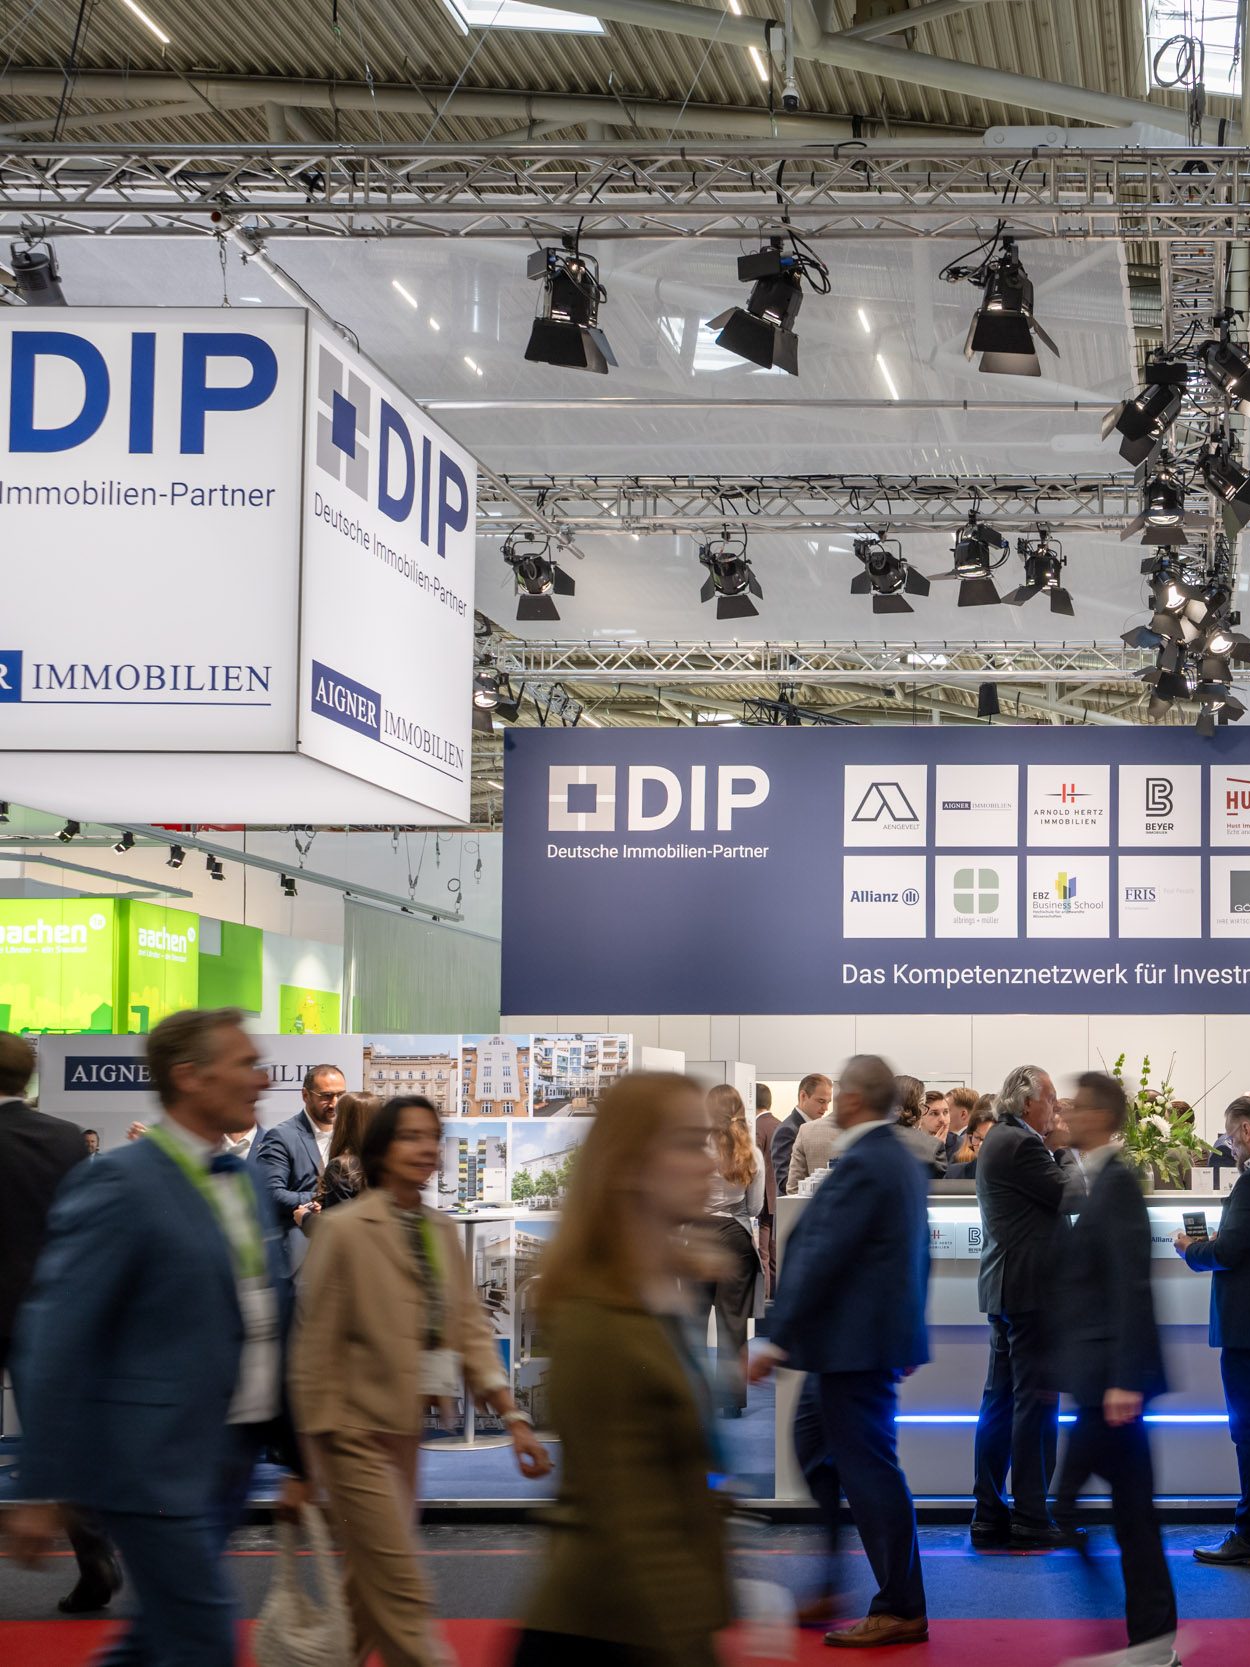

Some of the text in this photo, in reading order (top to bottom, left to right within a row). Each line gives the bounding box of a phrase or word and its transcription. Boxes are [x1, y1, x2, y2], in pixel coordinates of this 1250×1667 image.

[9, 331, 279, 455] DIP
[378, 397, 470, 559] DIP
[0, 479, 276, 508] Immobilien-Partner
[314, 491, 468, 619] Deutsche Immobilien-Partner
[33, 664, 272, 692] IMMOBILIEN
[315, 674, 464, 770] AIGNER IMMOBILIEN
[627, 765, 770, 831] DIP
[944, 802, 1012, 810] AIGNER IMMOBILIEN
[1145, 822, 1174, 831] BEYER
[547, 844, 769, 858] Deutsche Immobilien-Partner
[850, 890, 899, 903] Allianz
[1032, 892, 1050, 900] EBZ
[1032, 901, 1104, 909] Business School
[1125, 888, 1156, 901] FRIS
[138, 926, 187, 953] aachen
[842, 964, 886, 984] Das
[893, 963, 1128, 989] Kompetenznetzwerk
[1135, 963, 1167, 984] für
[71, 1064, 152, 1083] AIGNE
